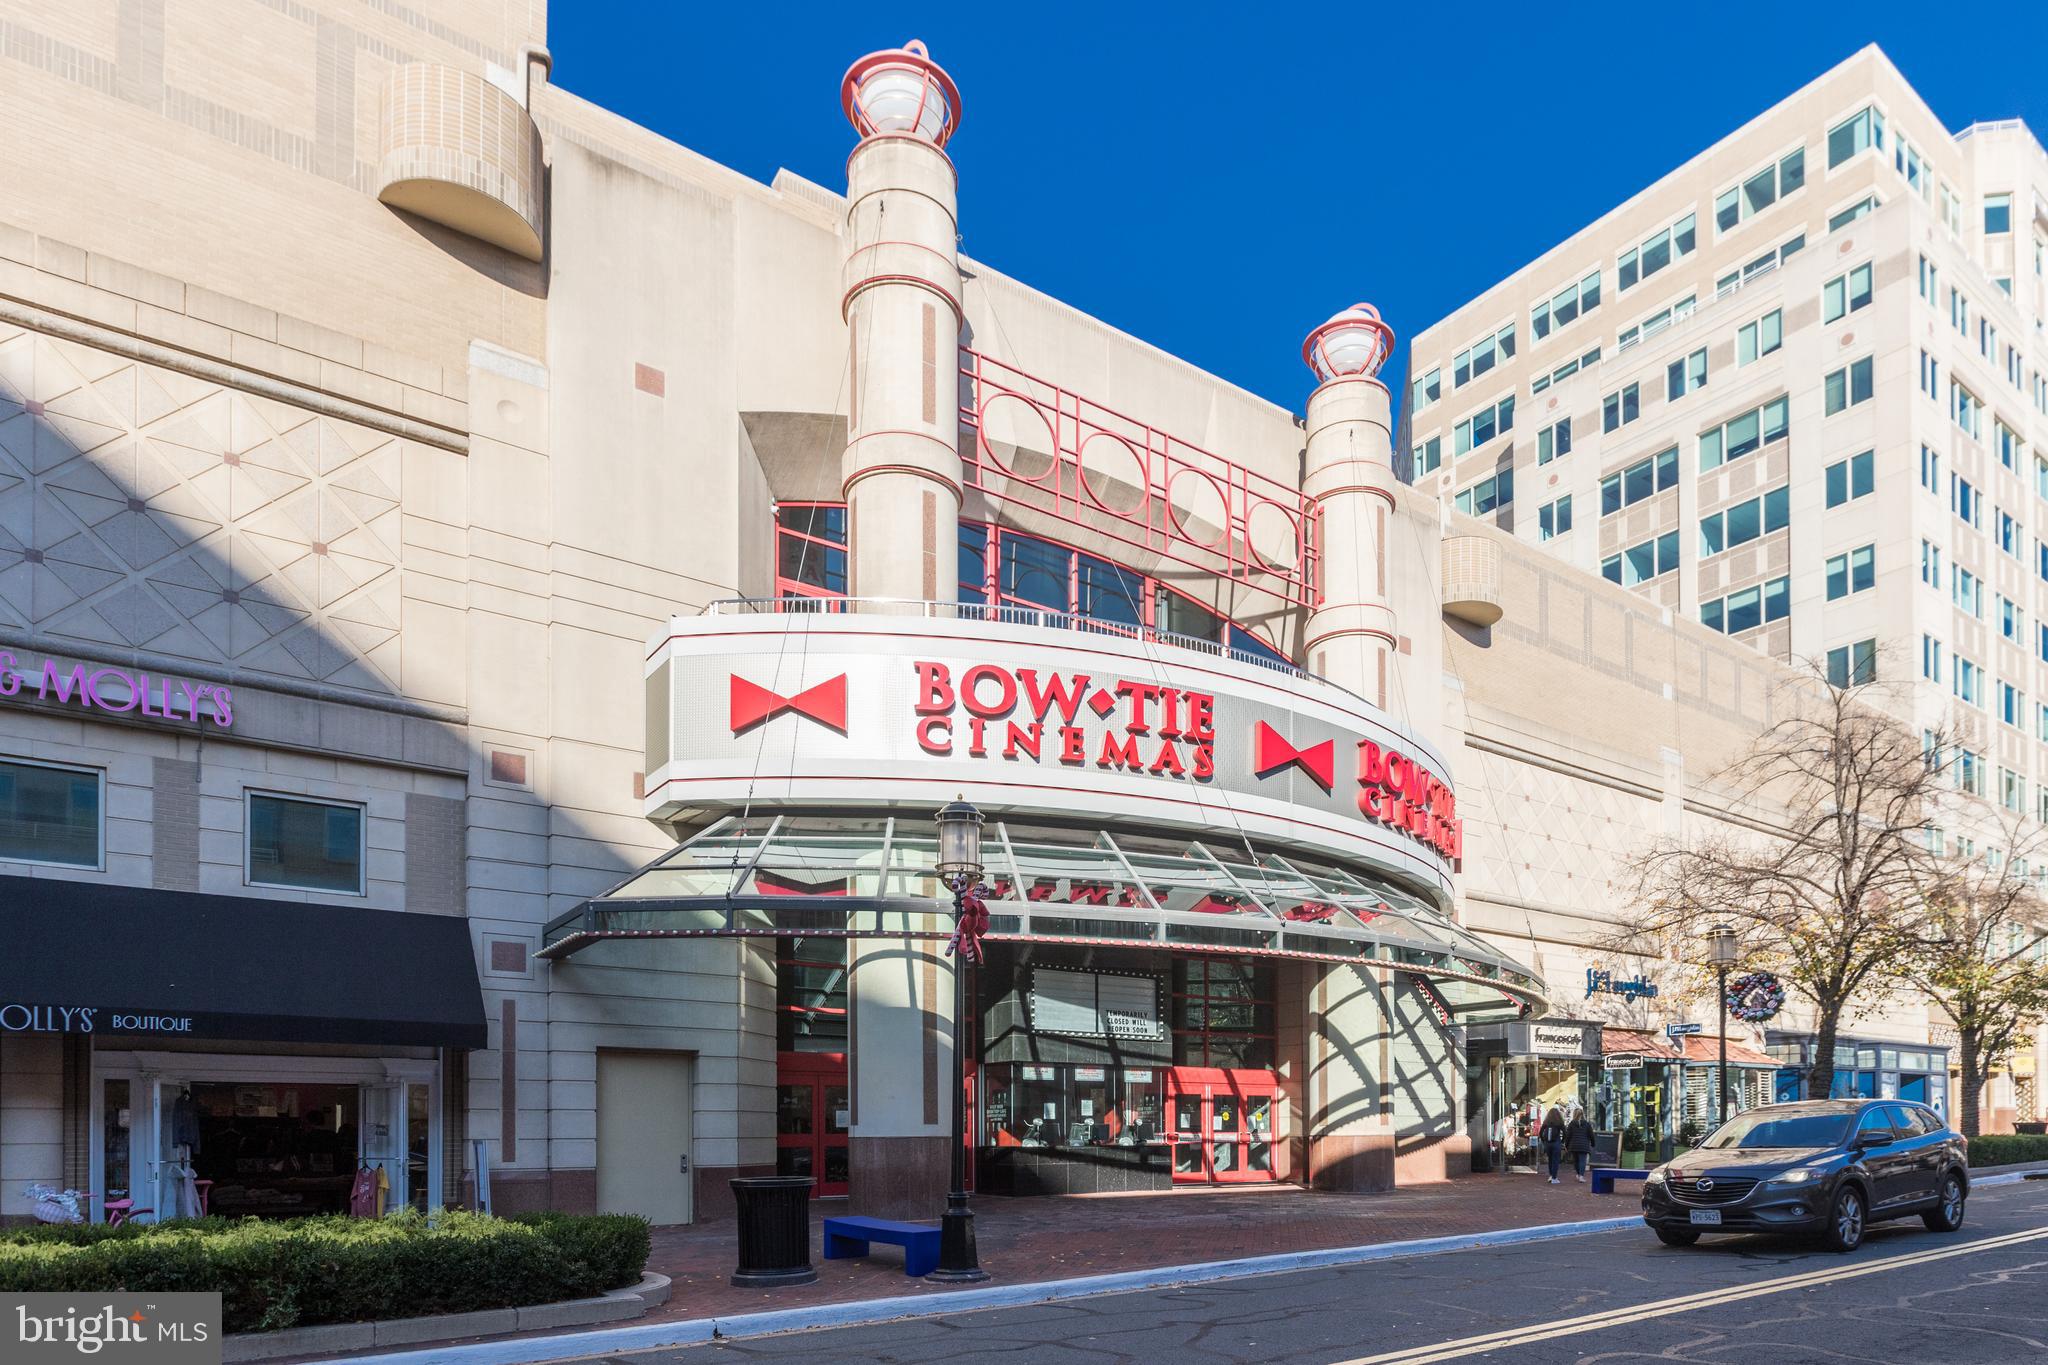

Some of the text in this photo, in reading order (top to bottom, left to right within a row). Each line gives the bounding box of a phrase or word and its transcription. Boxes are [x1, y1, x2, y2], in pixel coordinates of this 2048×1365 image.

[38, 658, 233, 727] MOLLY'S
[915, 715, 1214, 783] CINEMAS
[112, 1014, 192, 1032] BOUTIQUE
[1106, 1009, 1148, 1019] TEMPORARILY
